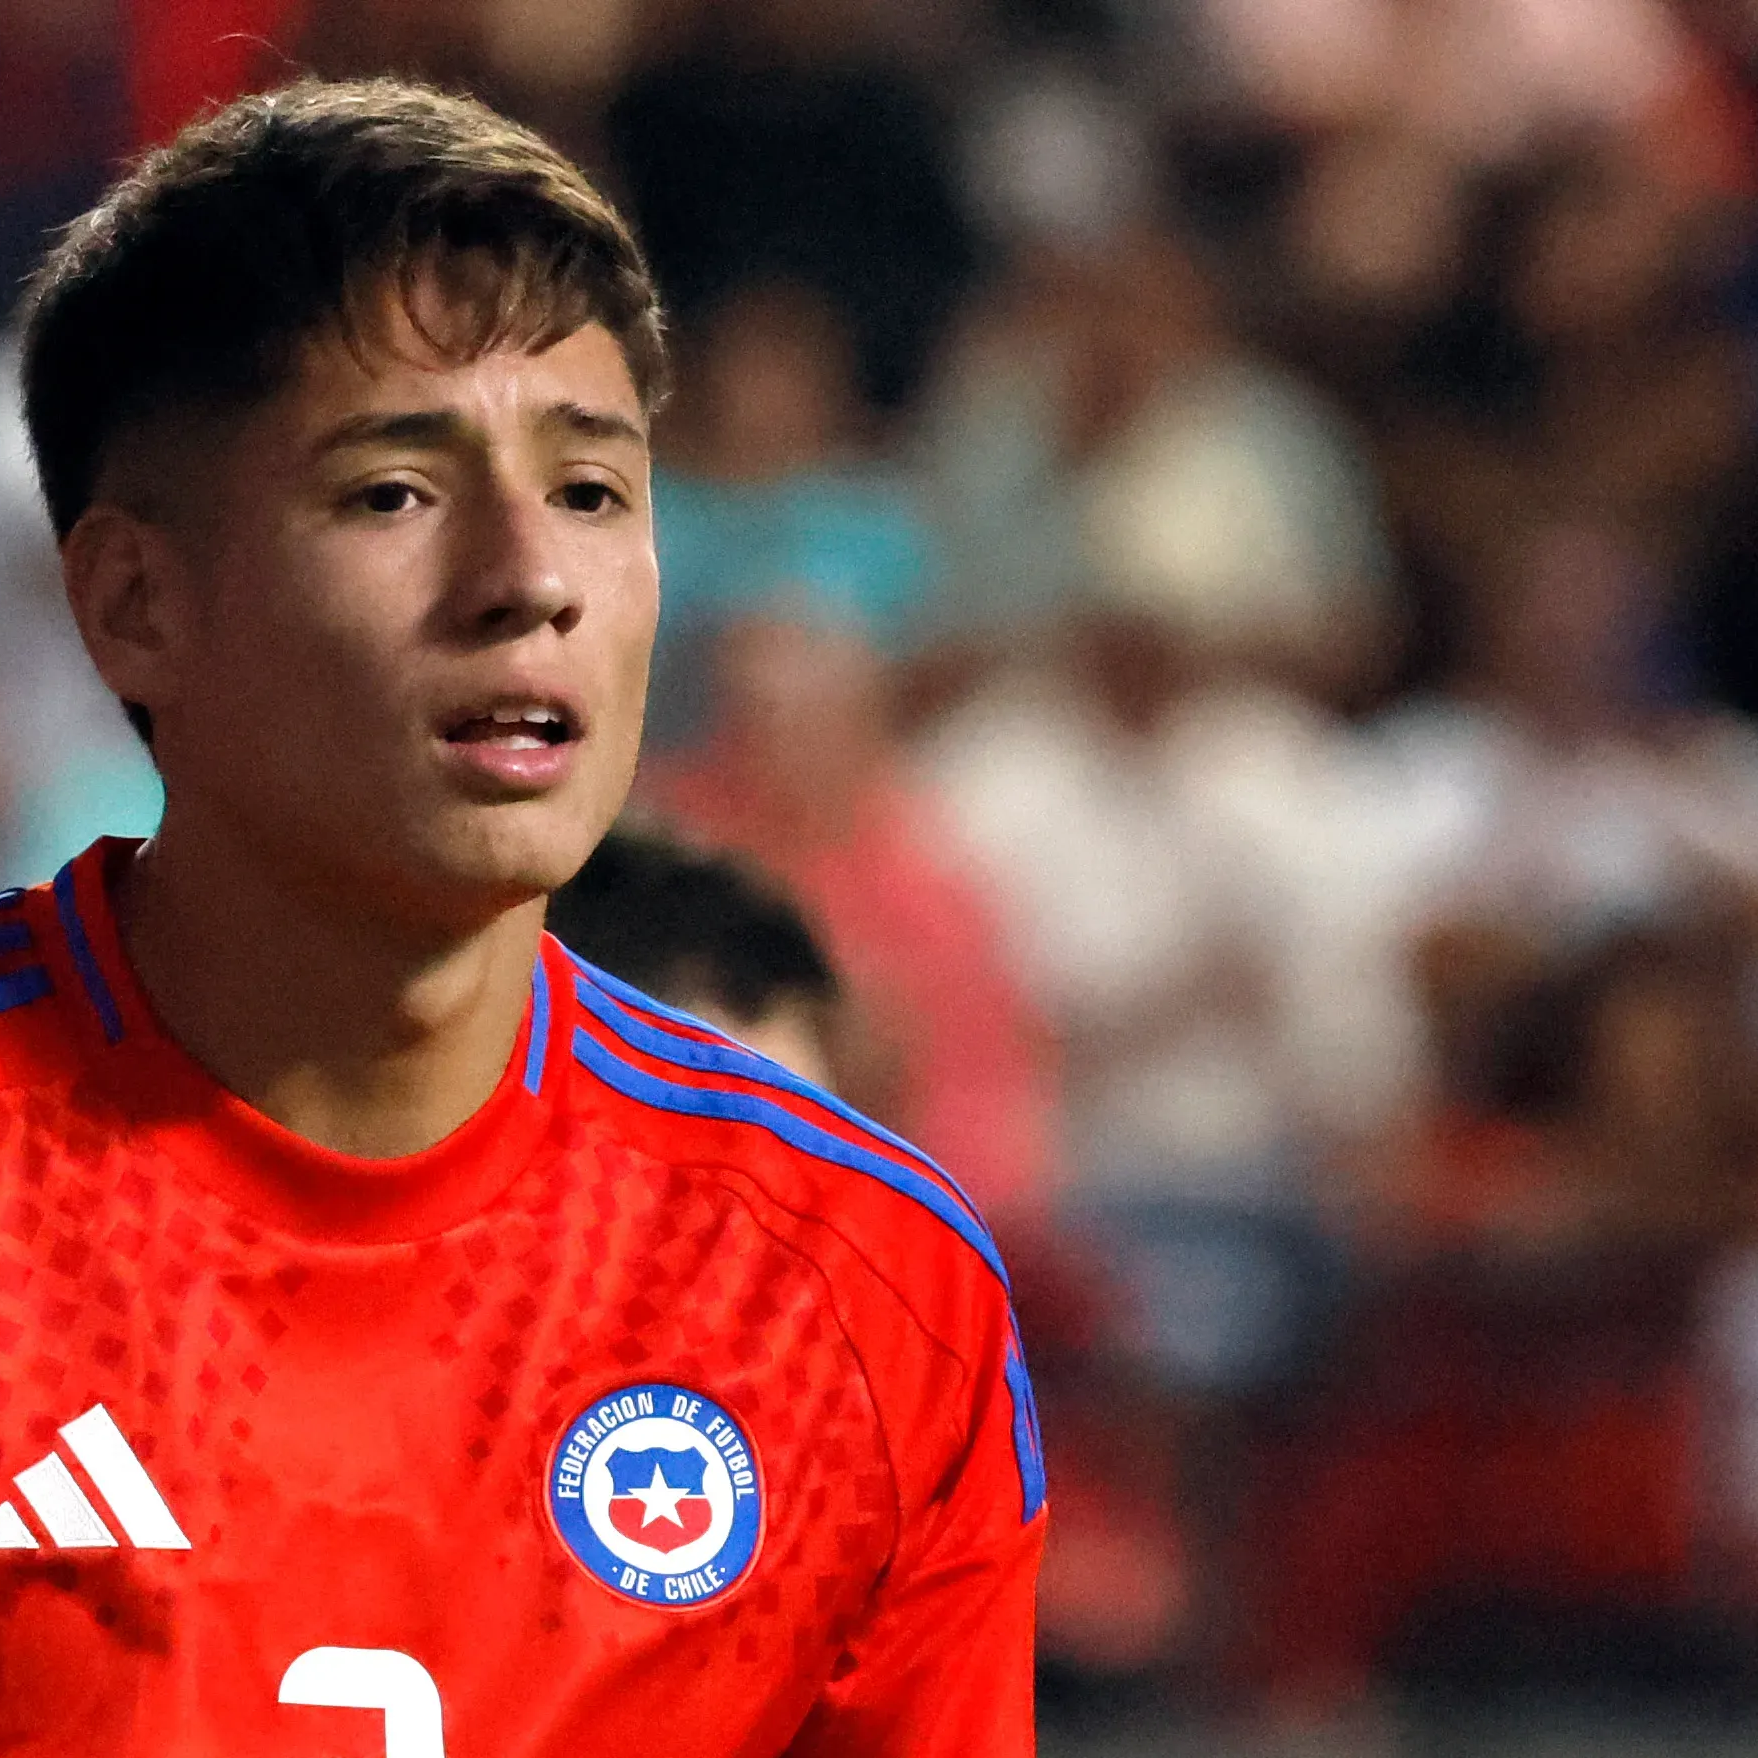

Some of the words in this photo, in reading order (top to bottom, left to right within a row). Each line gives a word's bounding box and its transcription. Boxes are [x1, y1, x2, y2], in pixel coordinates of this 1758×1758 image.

[558, 1392, 655, 1500] FEDERACION
[671, 1394, 702, 1423] DE
[705, 1415, 755, 1501] FUTBOL
[619, 1565, 650, 1596] DE
[664, 1564, 724, 1600] CHILE
